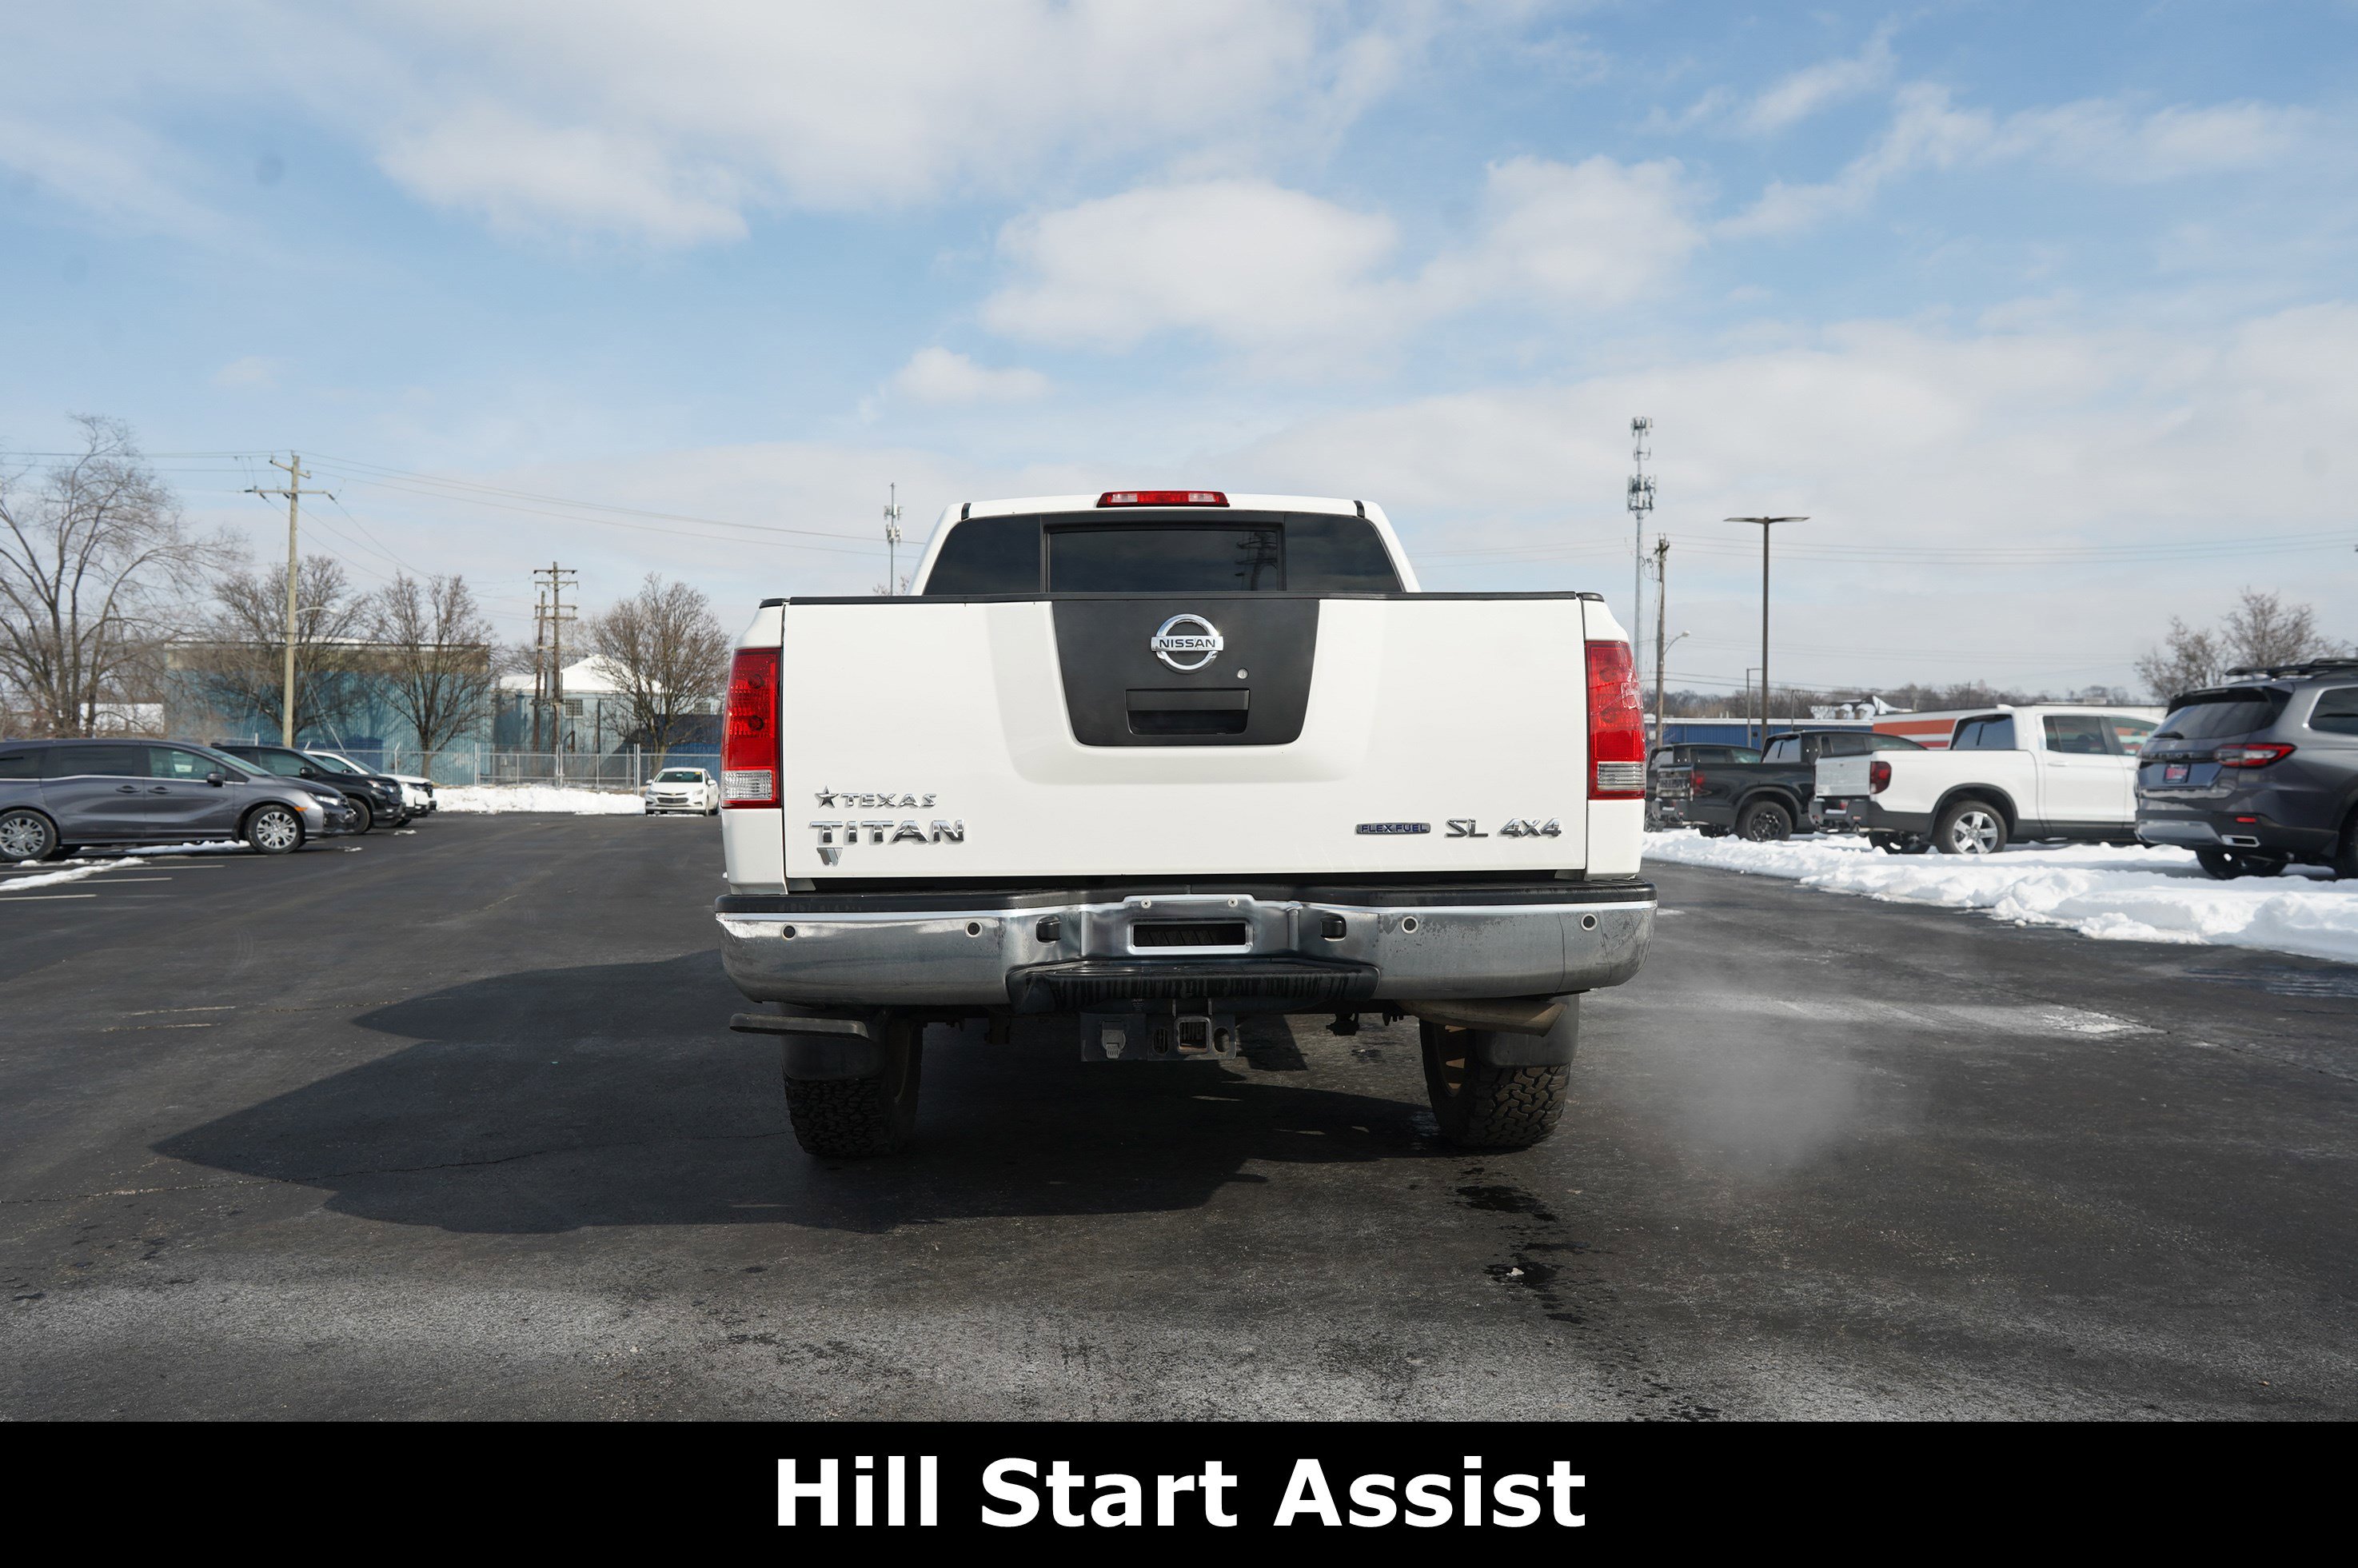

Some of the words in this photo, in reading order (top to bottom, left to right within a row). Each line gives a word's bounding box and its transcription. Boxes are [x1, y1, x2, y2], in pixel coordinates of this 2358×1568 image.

[1159, 639, 1215, 648] NISSAN
[840, 792, 937, 807] TEXAS
[810, 820, 964, 844] TITAN
[1395, 824, 1427, 832] FUEL
[1446, 818, 1489, 837] SL
[1499, 818, 1562, 837] 4X4
